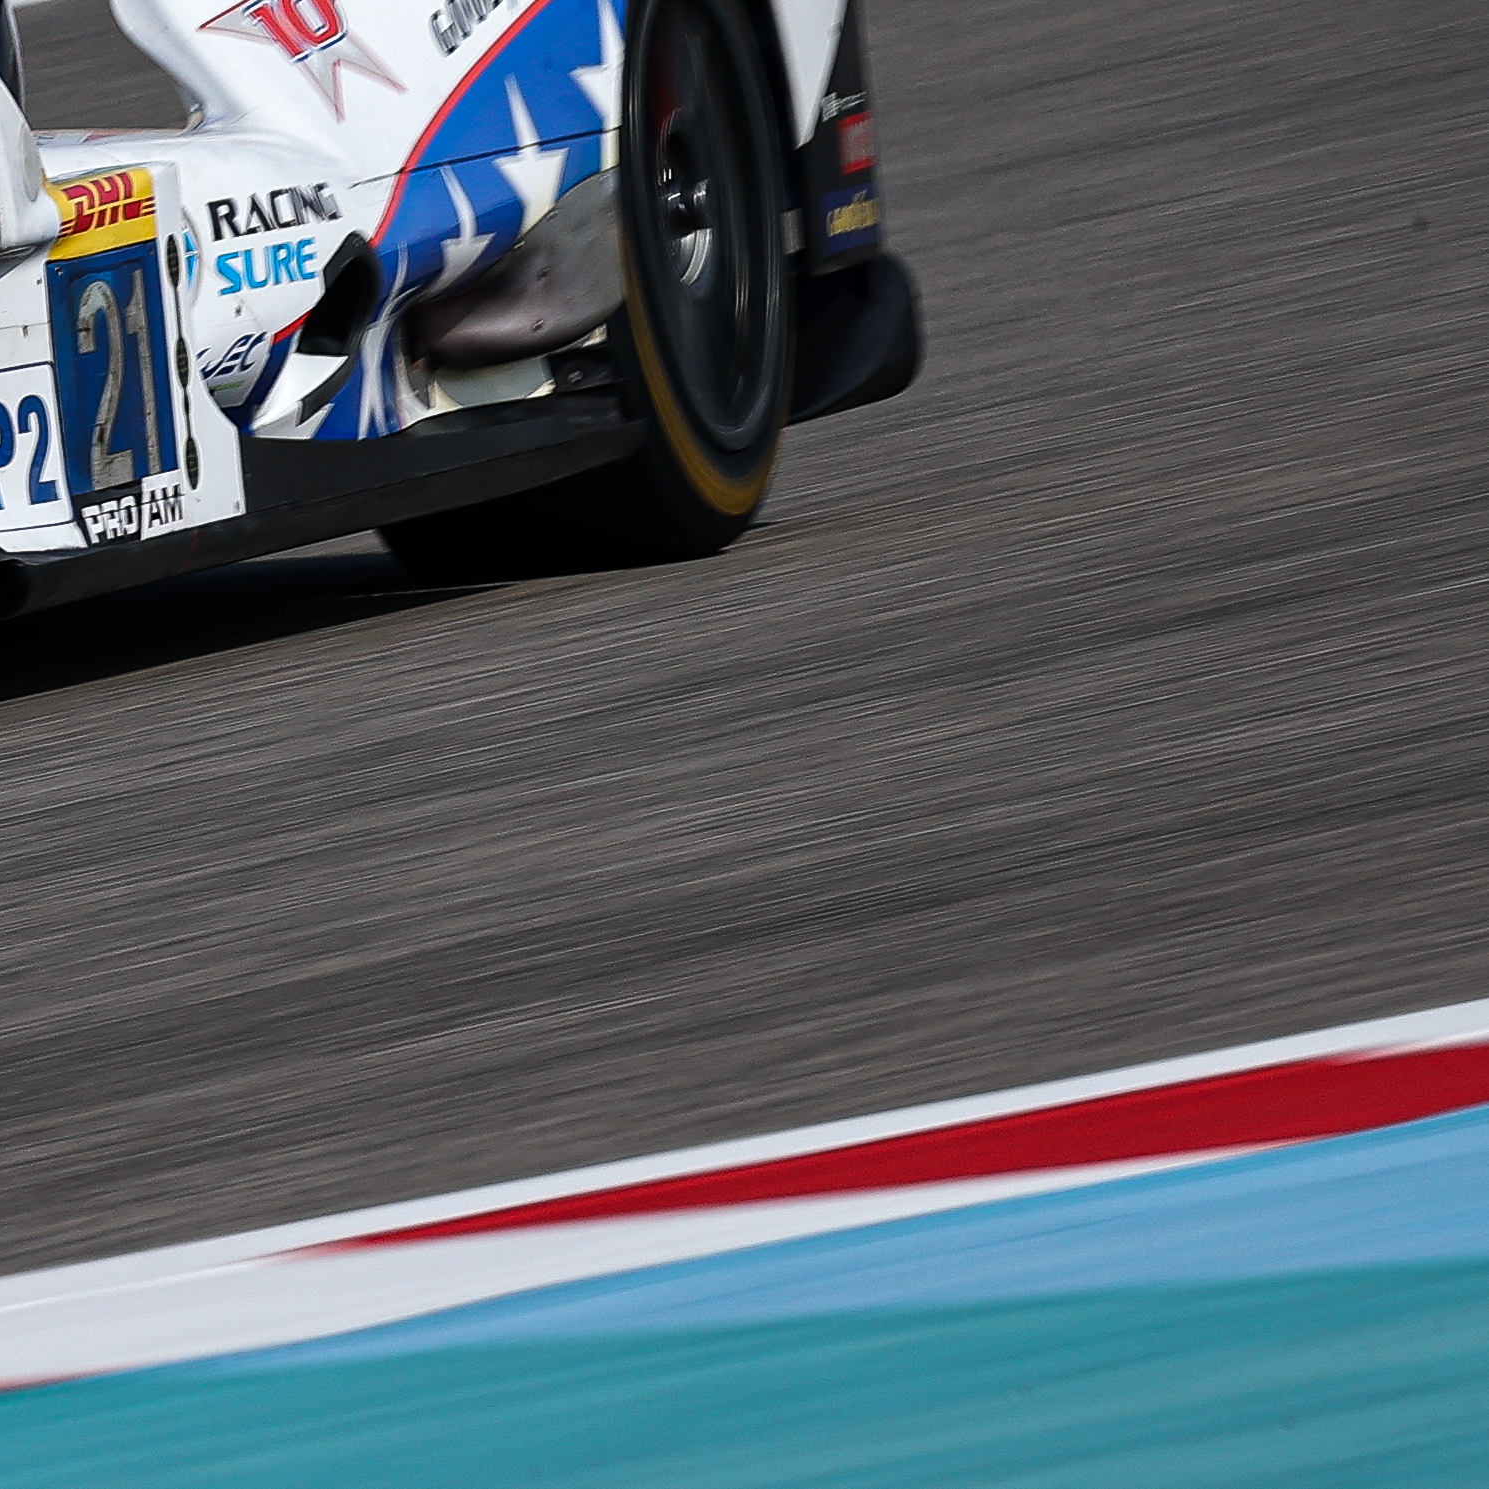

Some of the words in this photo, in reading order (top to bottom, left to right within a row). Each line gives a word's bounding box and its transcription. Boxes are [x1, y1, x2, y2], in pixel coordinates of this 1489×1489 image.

[61, 172, 146, 236] DHL
[206, 182, 344, 243] RACING
[215, 237, 319, 297] SURE
[76, 268, 162, 492] 21
[81, 495, 140, 544] PRO
[147, 484, 184, 529] AM
